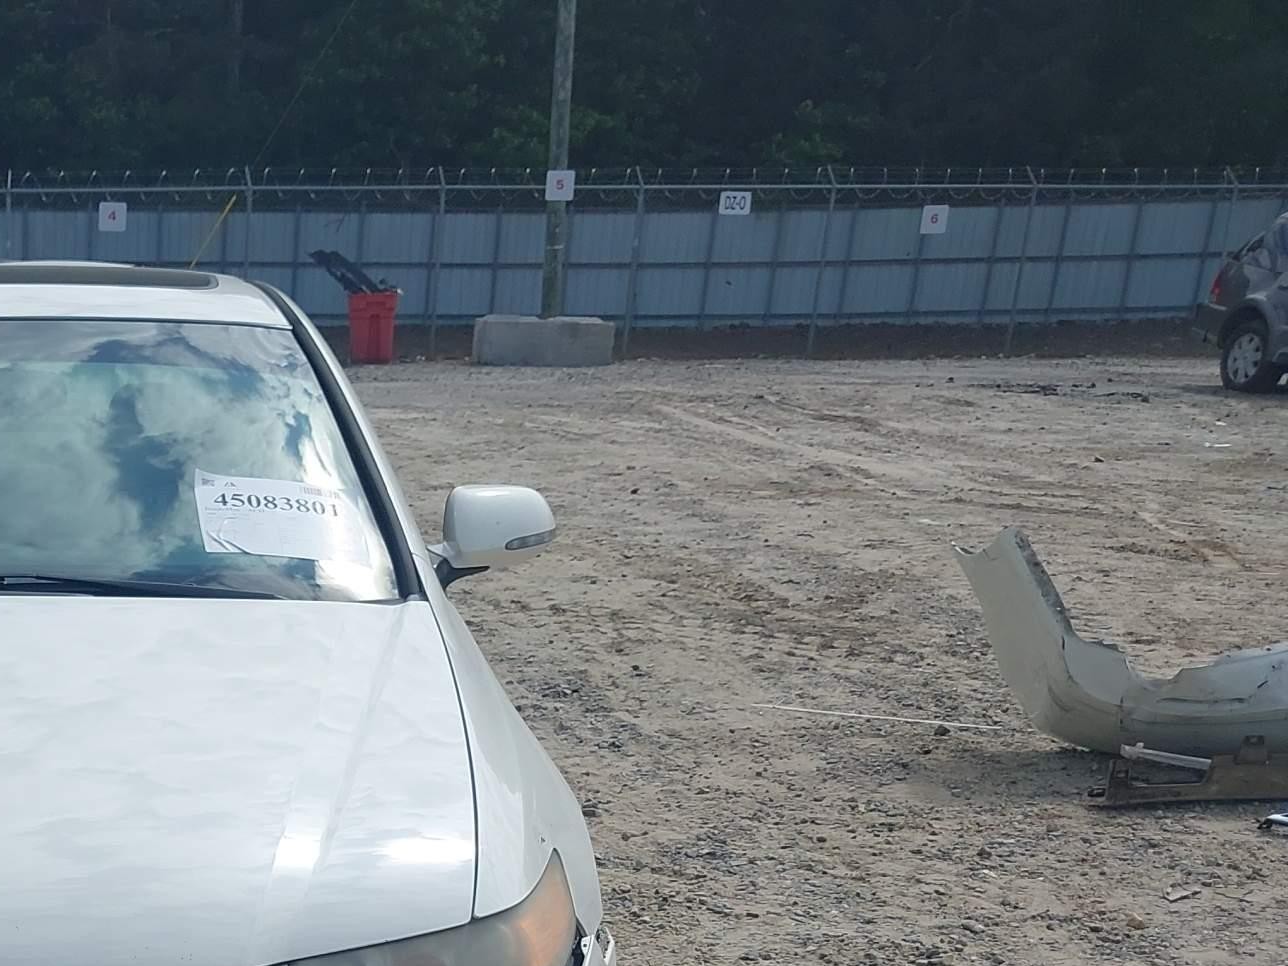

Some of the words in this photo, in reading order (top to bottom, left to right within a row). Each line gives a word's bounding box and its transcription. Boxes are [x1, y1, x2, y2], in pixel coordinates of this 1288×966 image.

[556, 179, 565, 190] 5
[108, 211, 116, 221] 4
[930, 213, 939, 224] 6
[213, 492, 339, 518] 45083801
